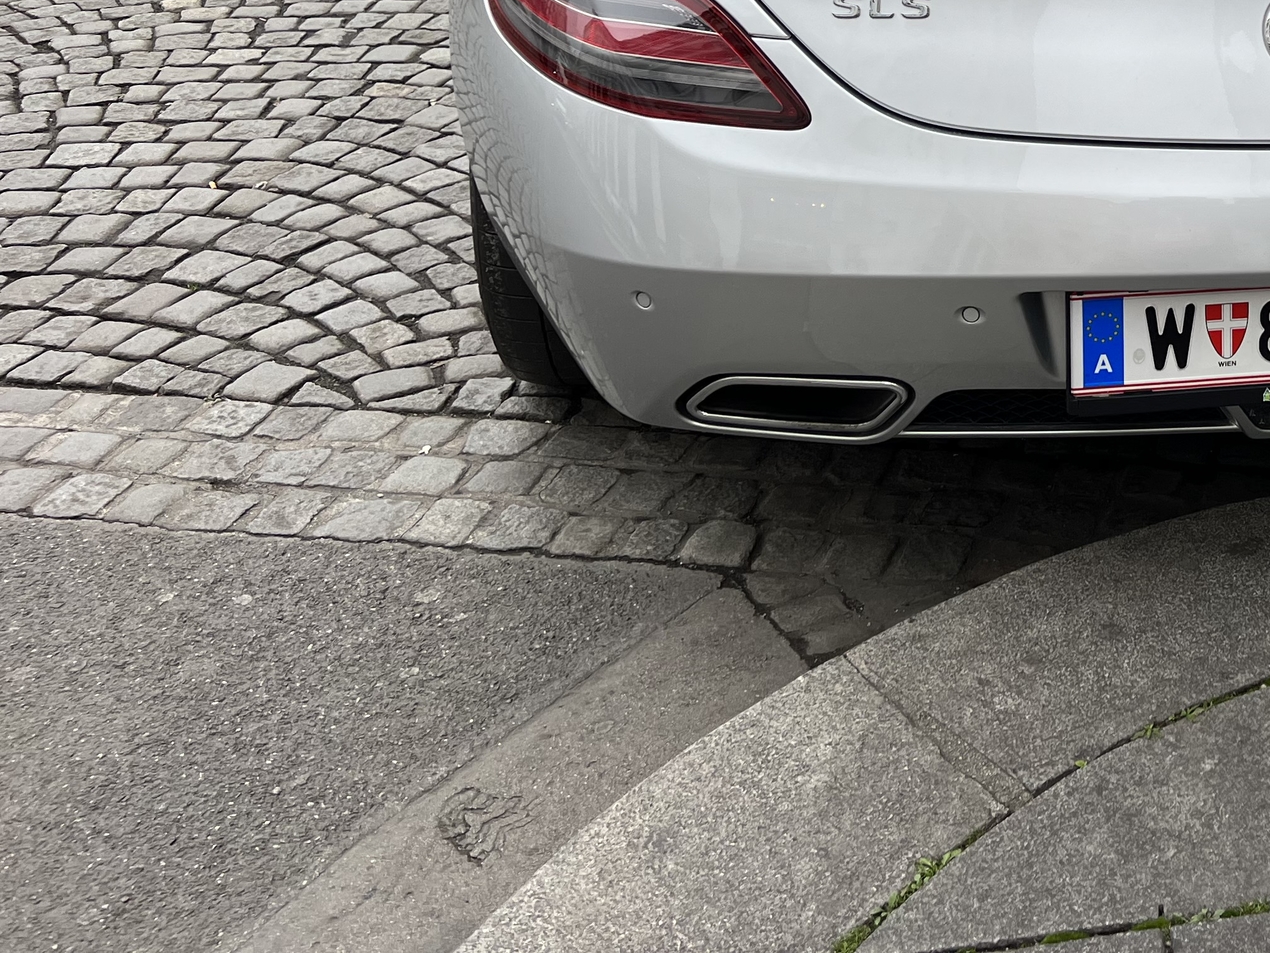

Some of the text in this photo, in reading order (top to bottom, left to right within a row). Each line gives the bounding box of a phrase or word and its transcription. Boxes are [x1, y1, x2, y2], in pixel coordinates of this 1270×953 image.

[1145, 302, 1196, 371] W
[1094, 354, 1113, 374] A
[1218, 360, 1237, 368] WIEN
